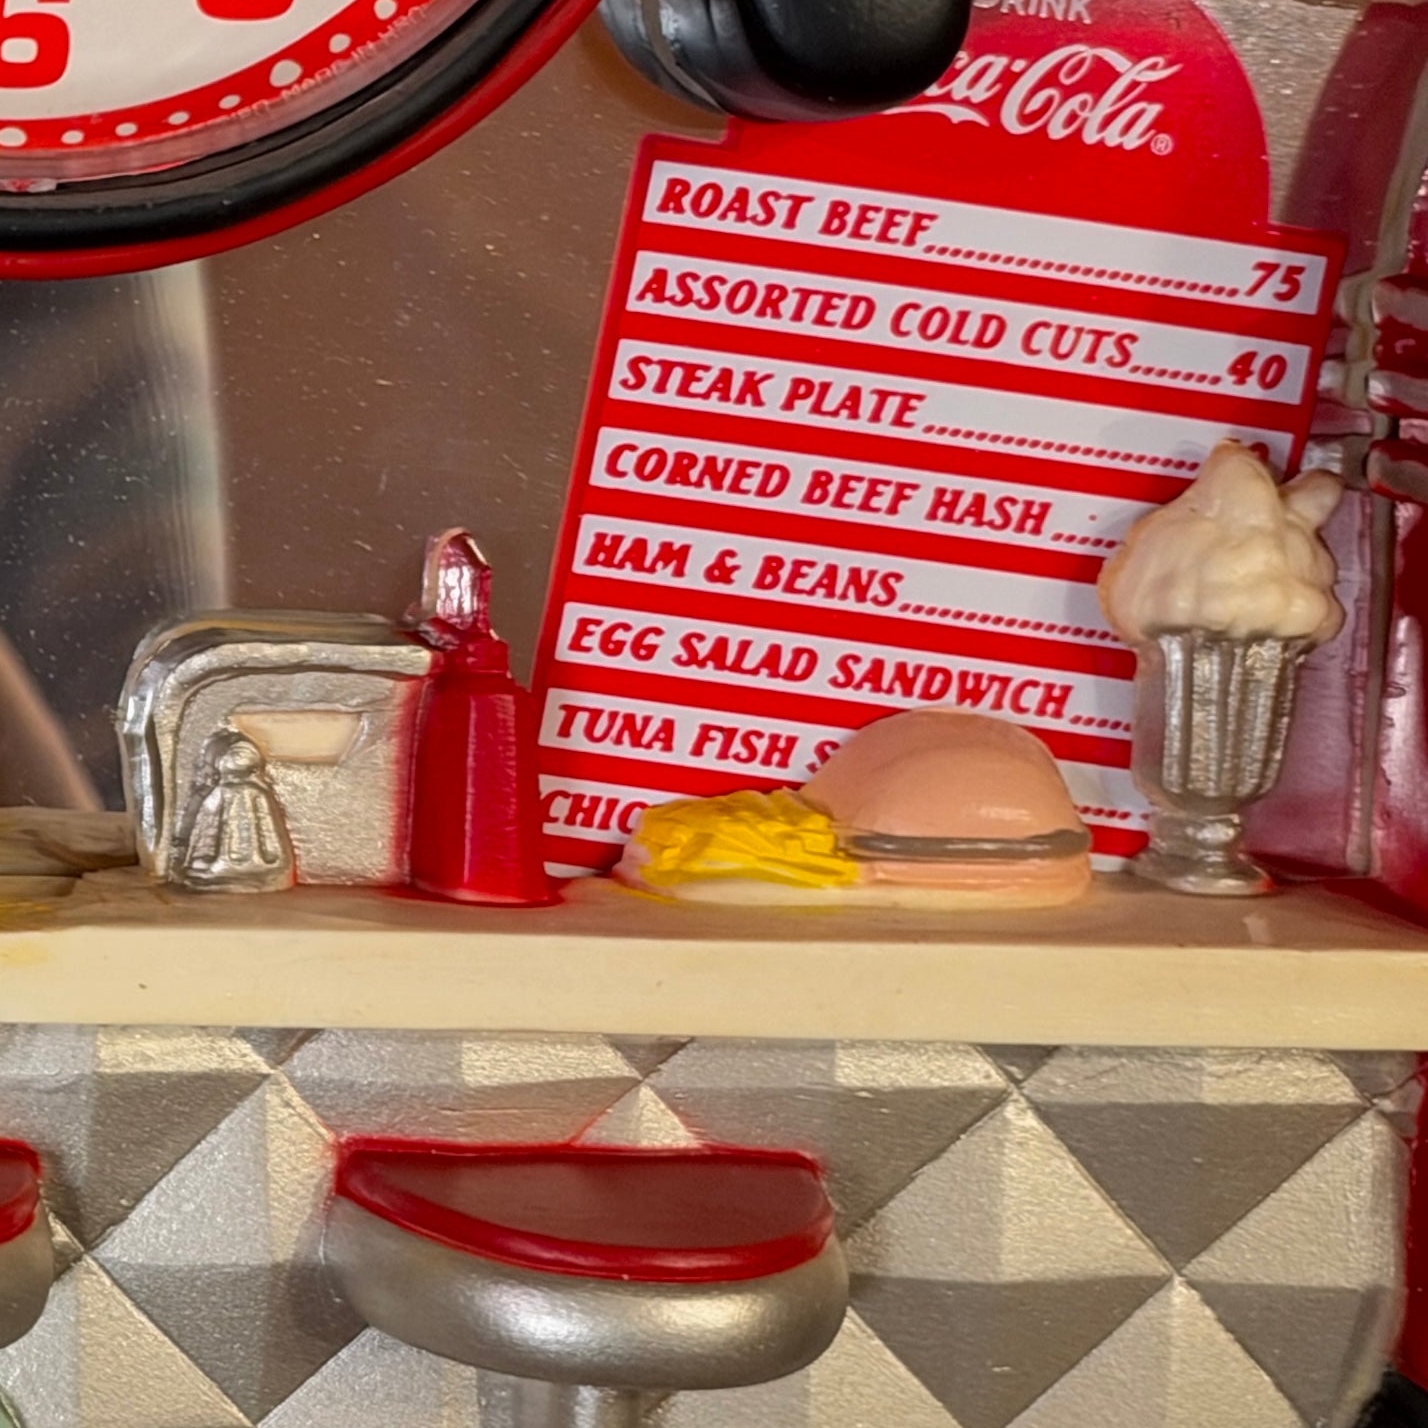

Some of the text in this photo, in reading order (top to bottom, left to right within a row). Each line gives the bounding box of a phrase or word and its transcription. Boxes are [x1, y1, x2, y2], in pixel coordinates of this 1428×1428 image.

[656, 178, 814, 229] ROAST
[1245, 261, 1306, 302] 75
[635, 268, 875, 331] ASSORTED
[889, 304, 1008, 353] COLD
[1227, 351, 1288, 391] 40
[619, 355, 776, 409] STEAK
[604, 444, 1053, 538] CORNED BEEF HASH
[584, 532, 904, 609] HAM & BEANS
[567, 619, 1073, 721] EGG SALAD SANDWICH
[555, 704, 677, 753] TUNA
[690, 723, 807, 771] FISH
